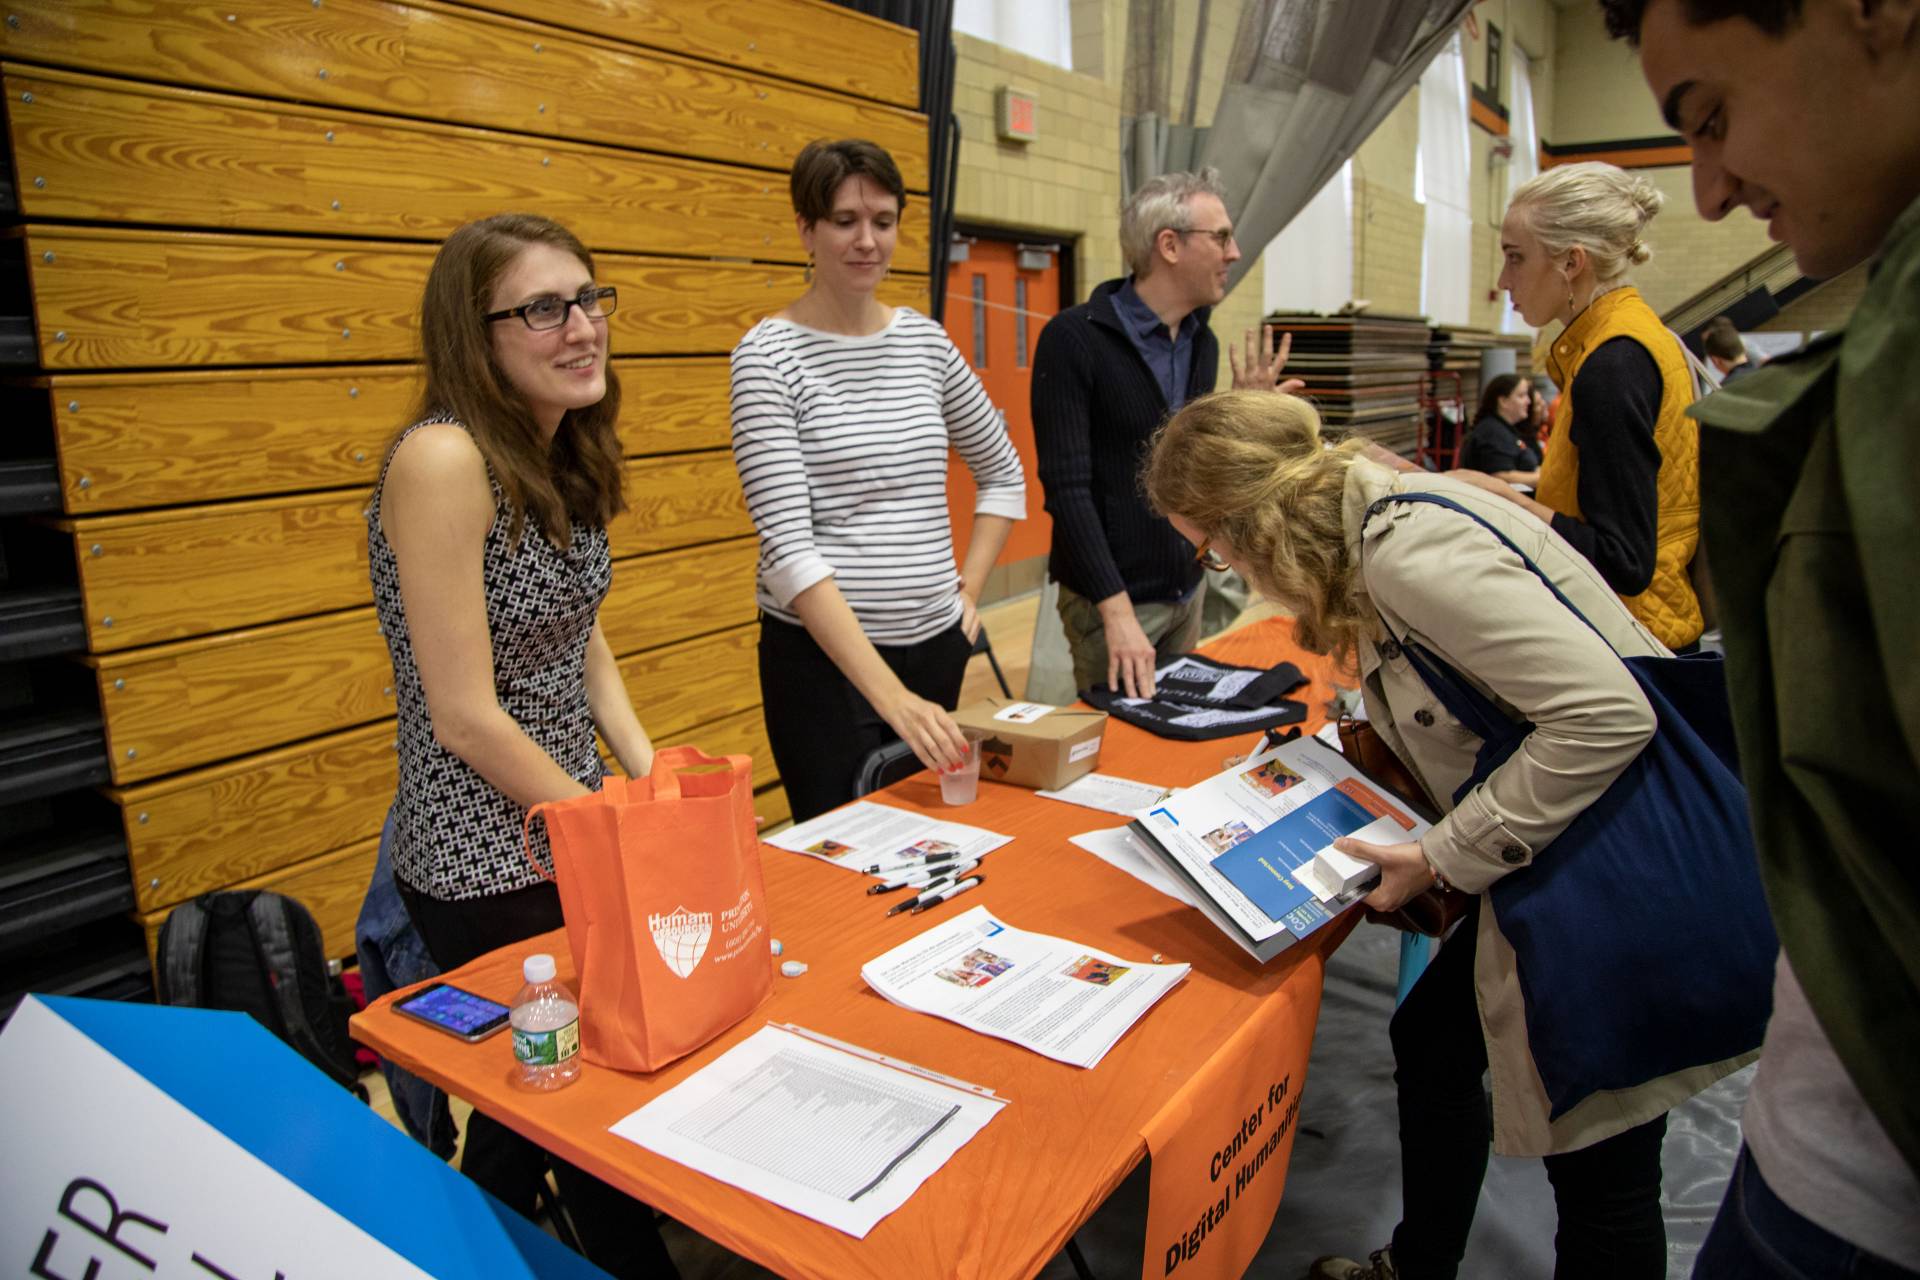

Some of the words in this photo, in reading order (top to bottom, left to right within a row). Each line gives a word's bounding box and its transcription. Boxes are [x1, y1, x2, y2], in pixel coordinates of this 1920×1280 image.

[648, 911, 713, 932] Human
[1210, 1103, 1264, 1183] Center
[1267, 1073, 1290, 1113] for
[1164, 1184, 1231, 1278] Digital
